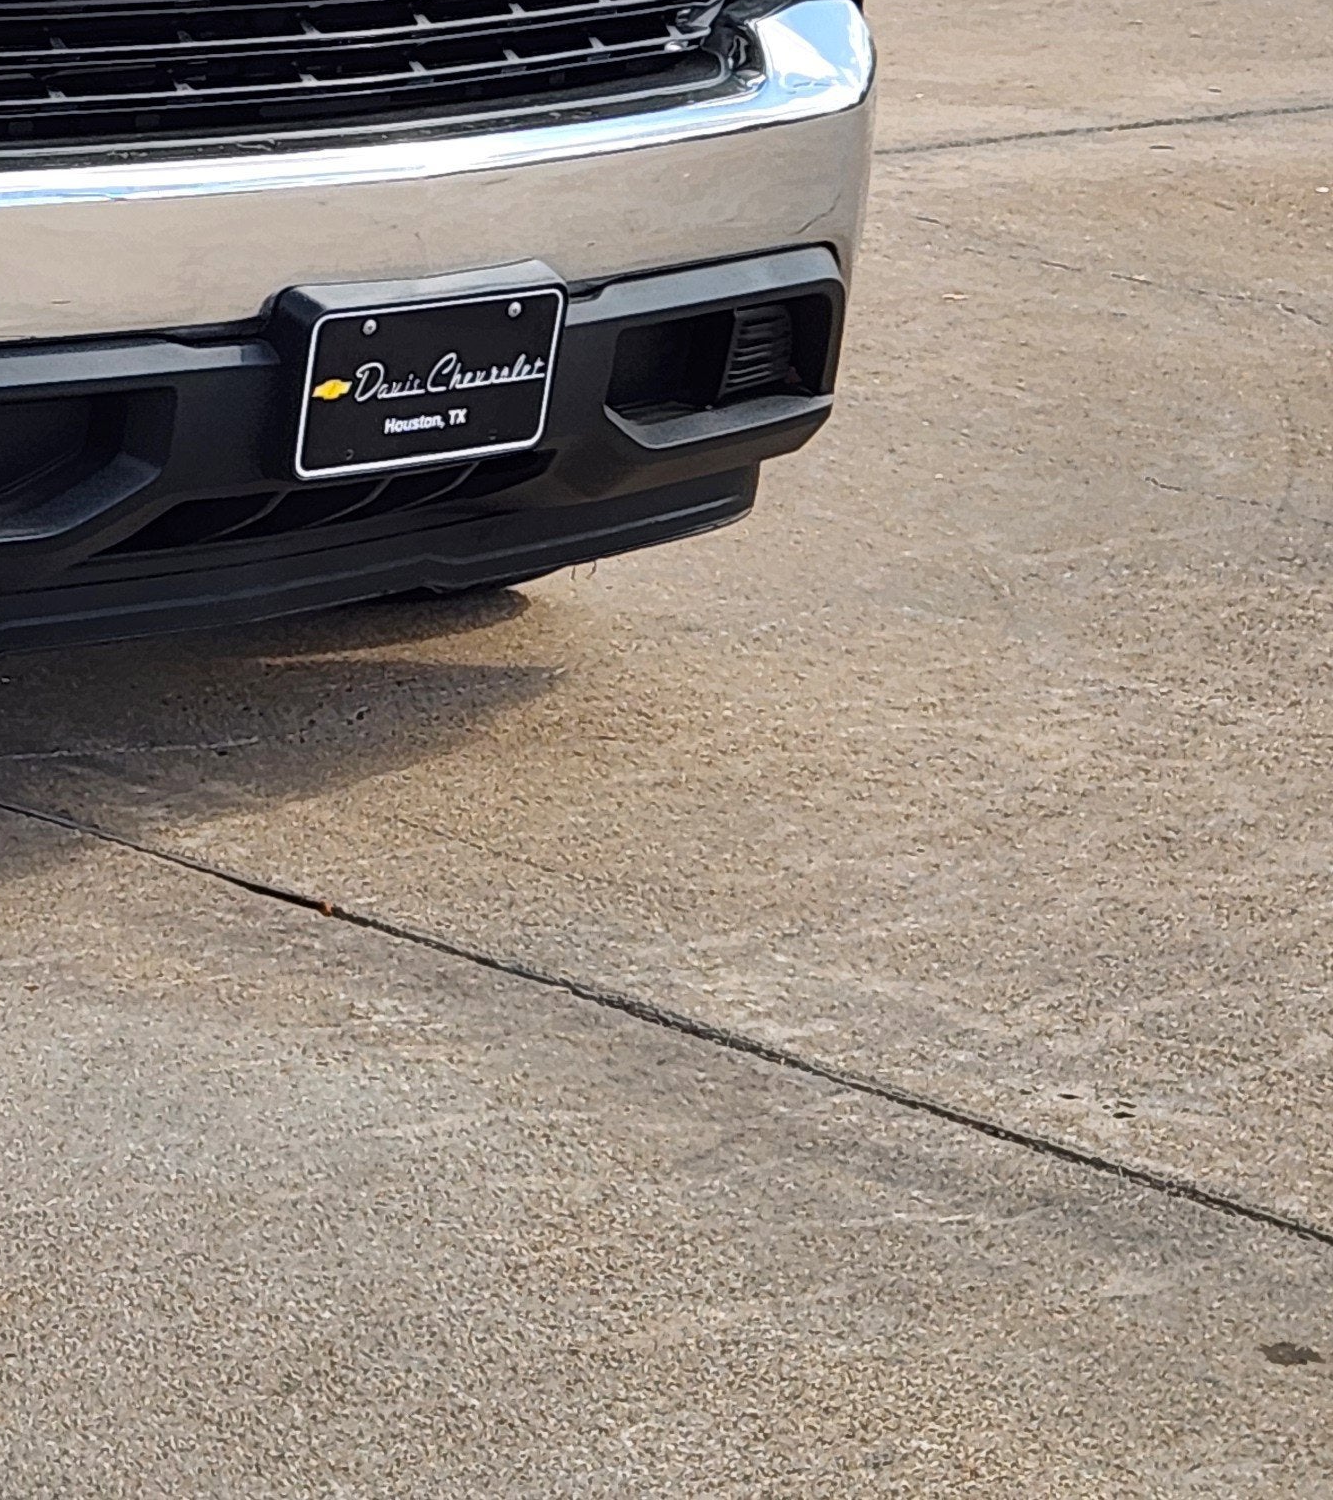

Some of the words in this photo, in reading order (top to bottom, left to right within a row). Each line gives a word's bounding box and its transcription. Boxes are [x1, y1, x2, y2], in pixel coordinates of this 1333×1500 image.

[354, 362, 426, 402] Davis
[427, 352, 546, 393] Chevrolet
[384, 413, 445, 435] Houston,
[449, 408, 468, 425] TX
